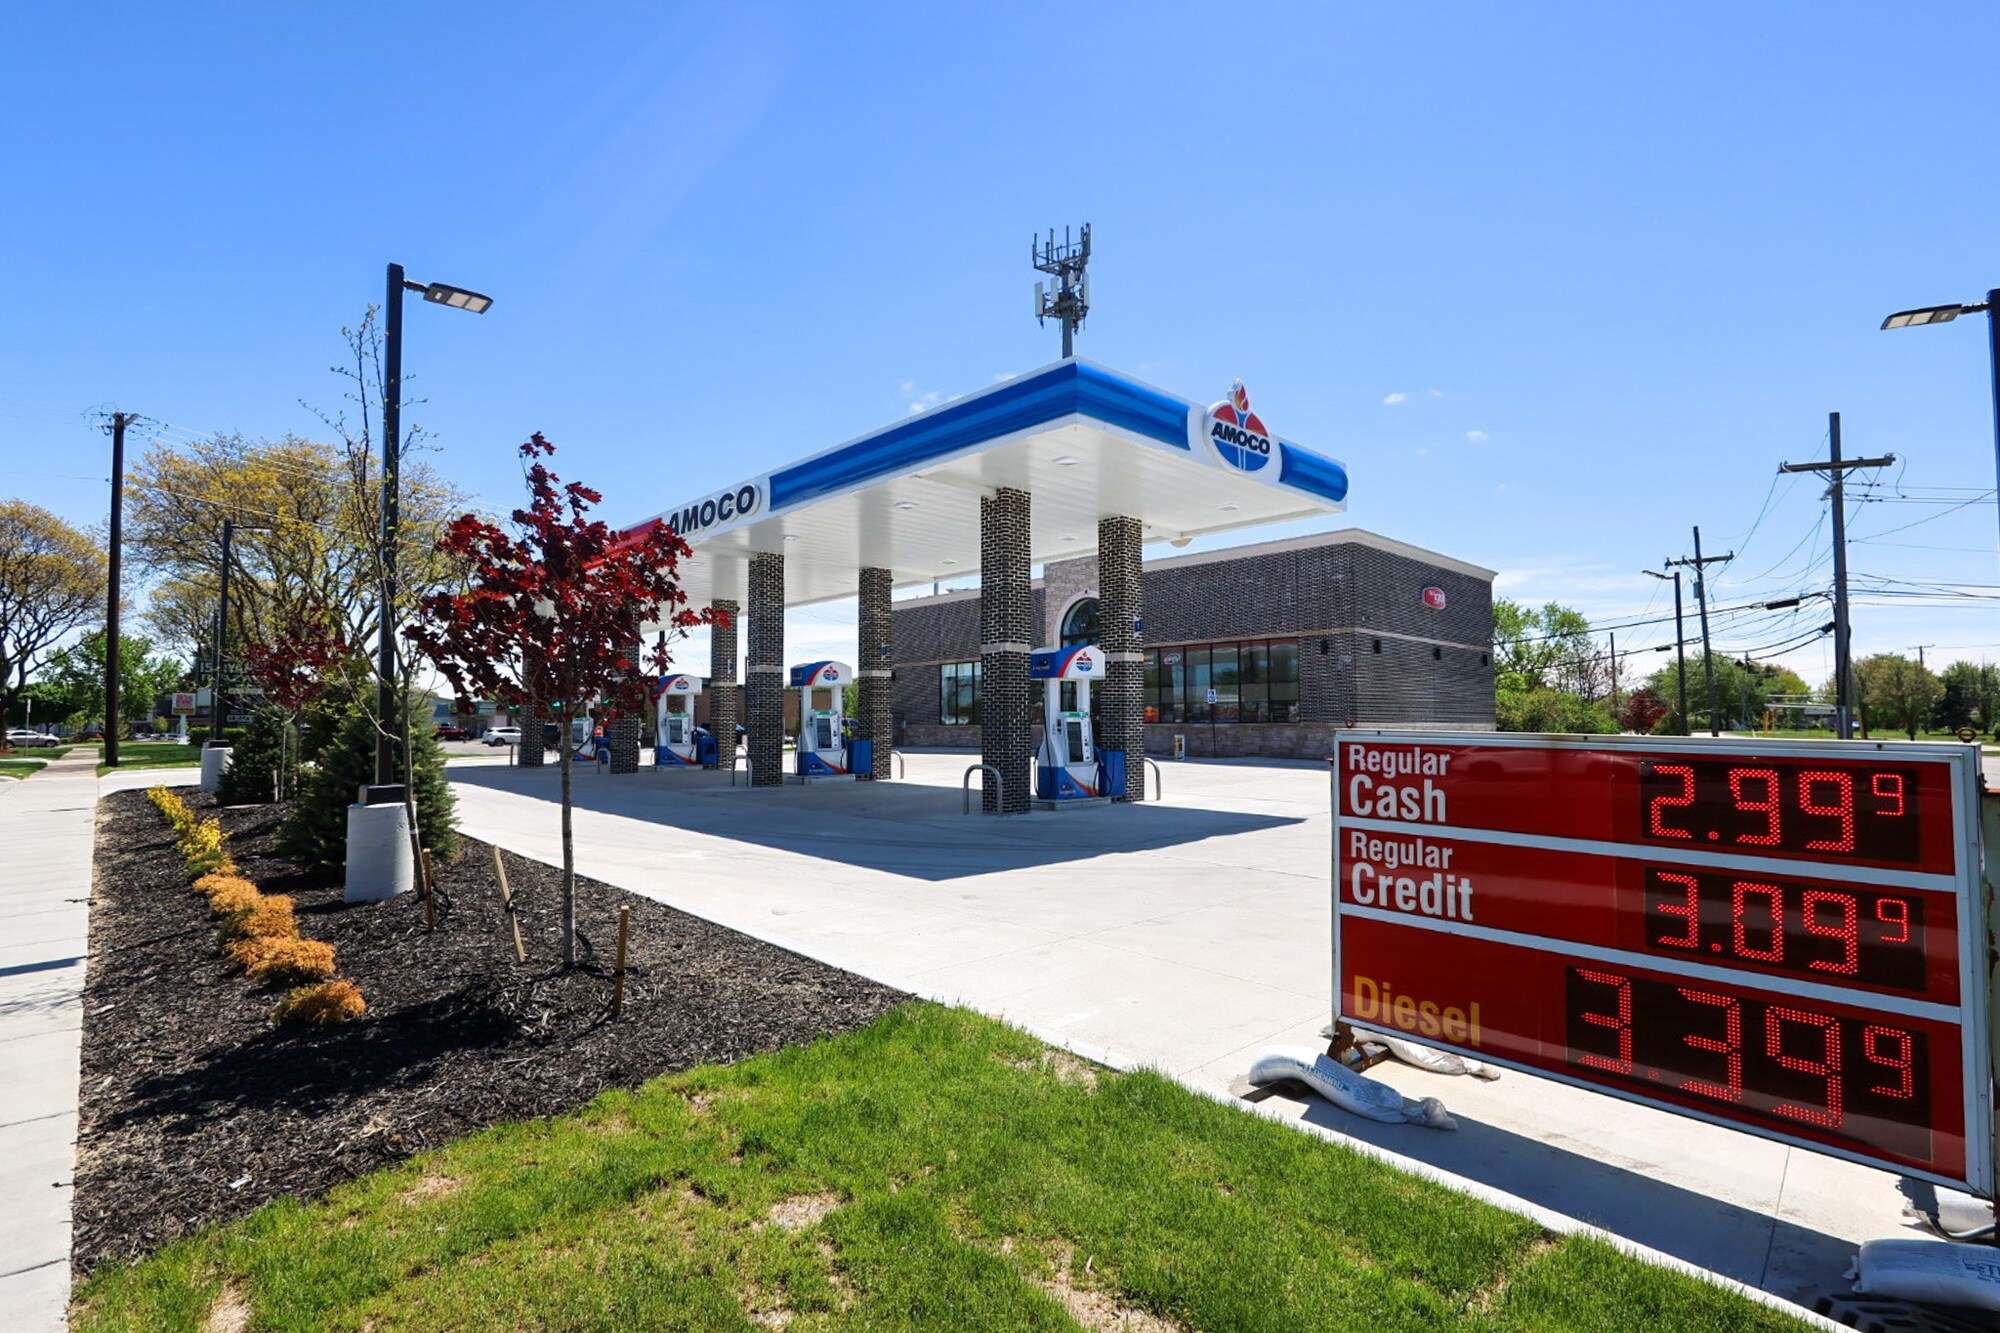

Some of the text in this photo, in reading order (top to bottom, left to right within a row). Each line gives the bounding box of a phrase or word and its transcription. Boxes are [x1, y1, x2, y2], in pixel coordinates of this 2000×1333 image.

[1211, 421, 1270, 455] AMOCO
[669, 485, 755, 536] AMOCO
[1349, 744, 1451, 779] Regular
[1350, 773, 1447, 823] Cash
[1651, 765, 1904, 853] 2.99 9
[1350, 831, 1453, 870] Regular
[1352, 861, 1474, 921] Credit
[1656, 871, 1908, 975] 3.09 9
[1354, 974, 1480, 1048] Diesel
[1575, 967, 1913, 1130] 3.39 9
